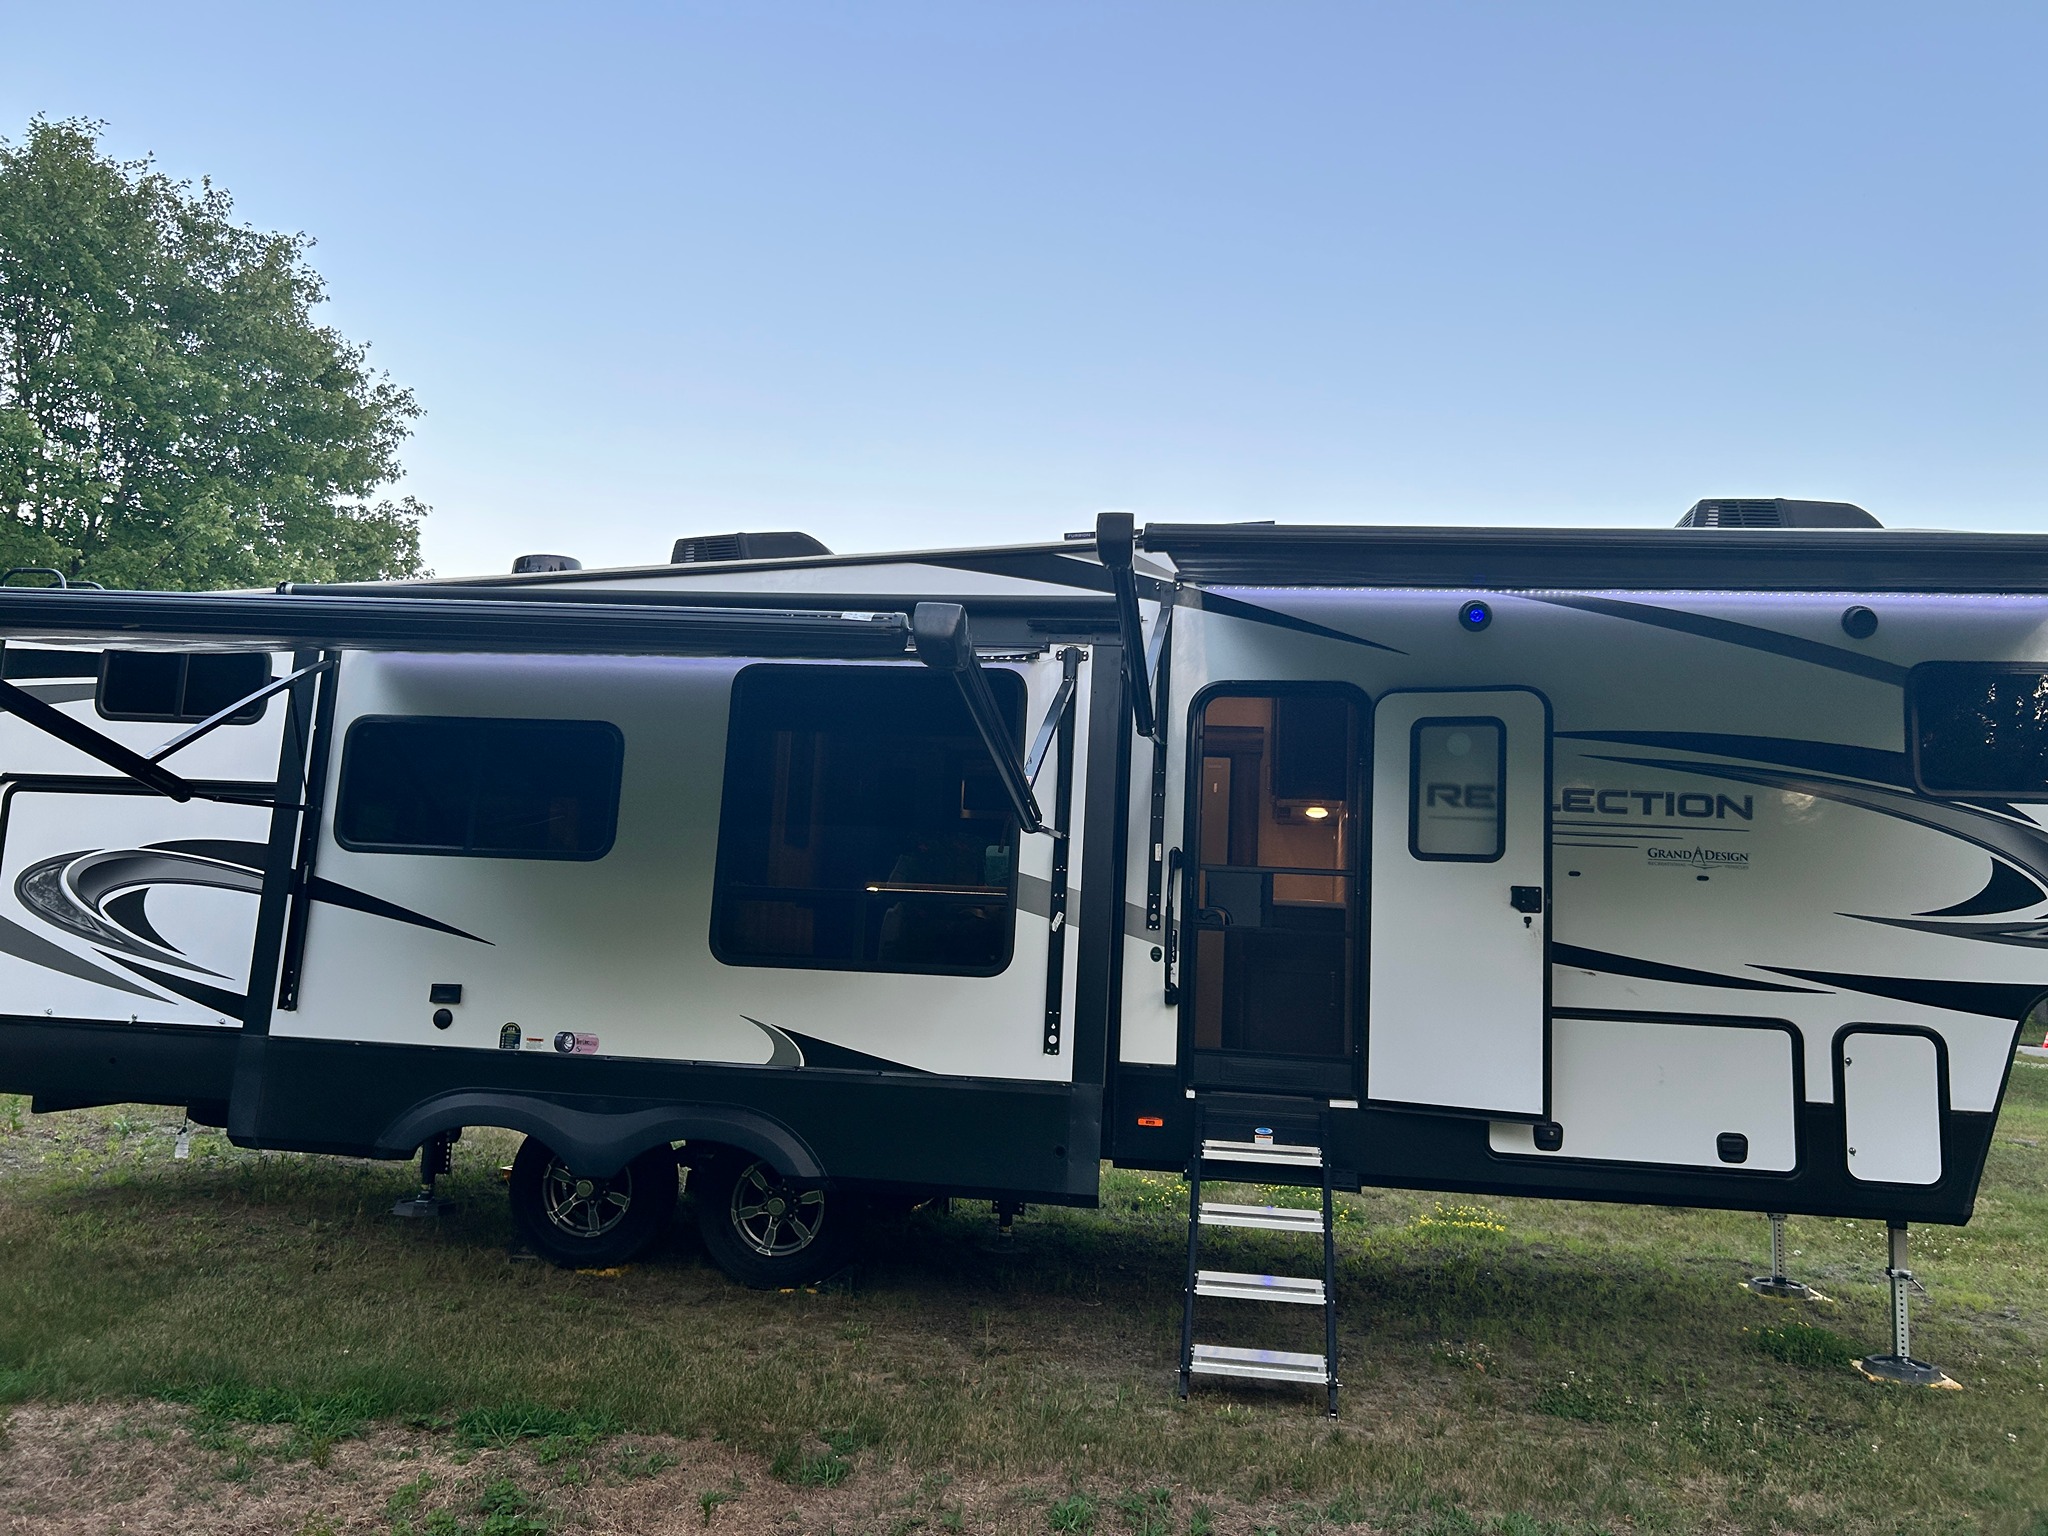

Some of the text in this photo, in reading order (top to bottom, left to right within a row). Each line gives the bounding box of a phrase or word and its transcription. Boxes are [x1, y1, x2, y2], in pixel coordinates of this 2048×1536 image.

[1427, 782, 1754, 821] REECTION
[1647, 847, 1749, 862] GRAND DESIGN
